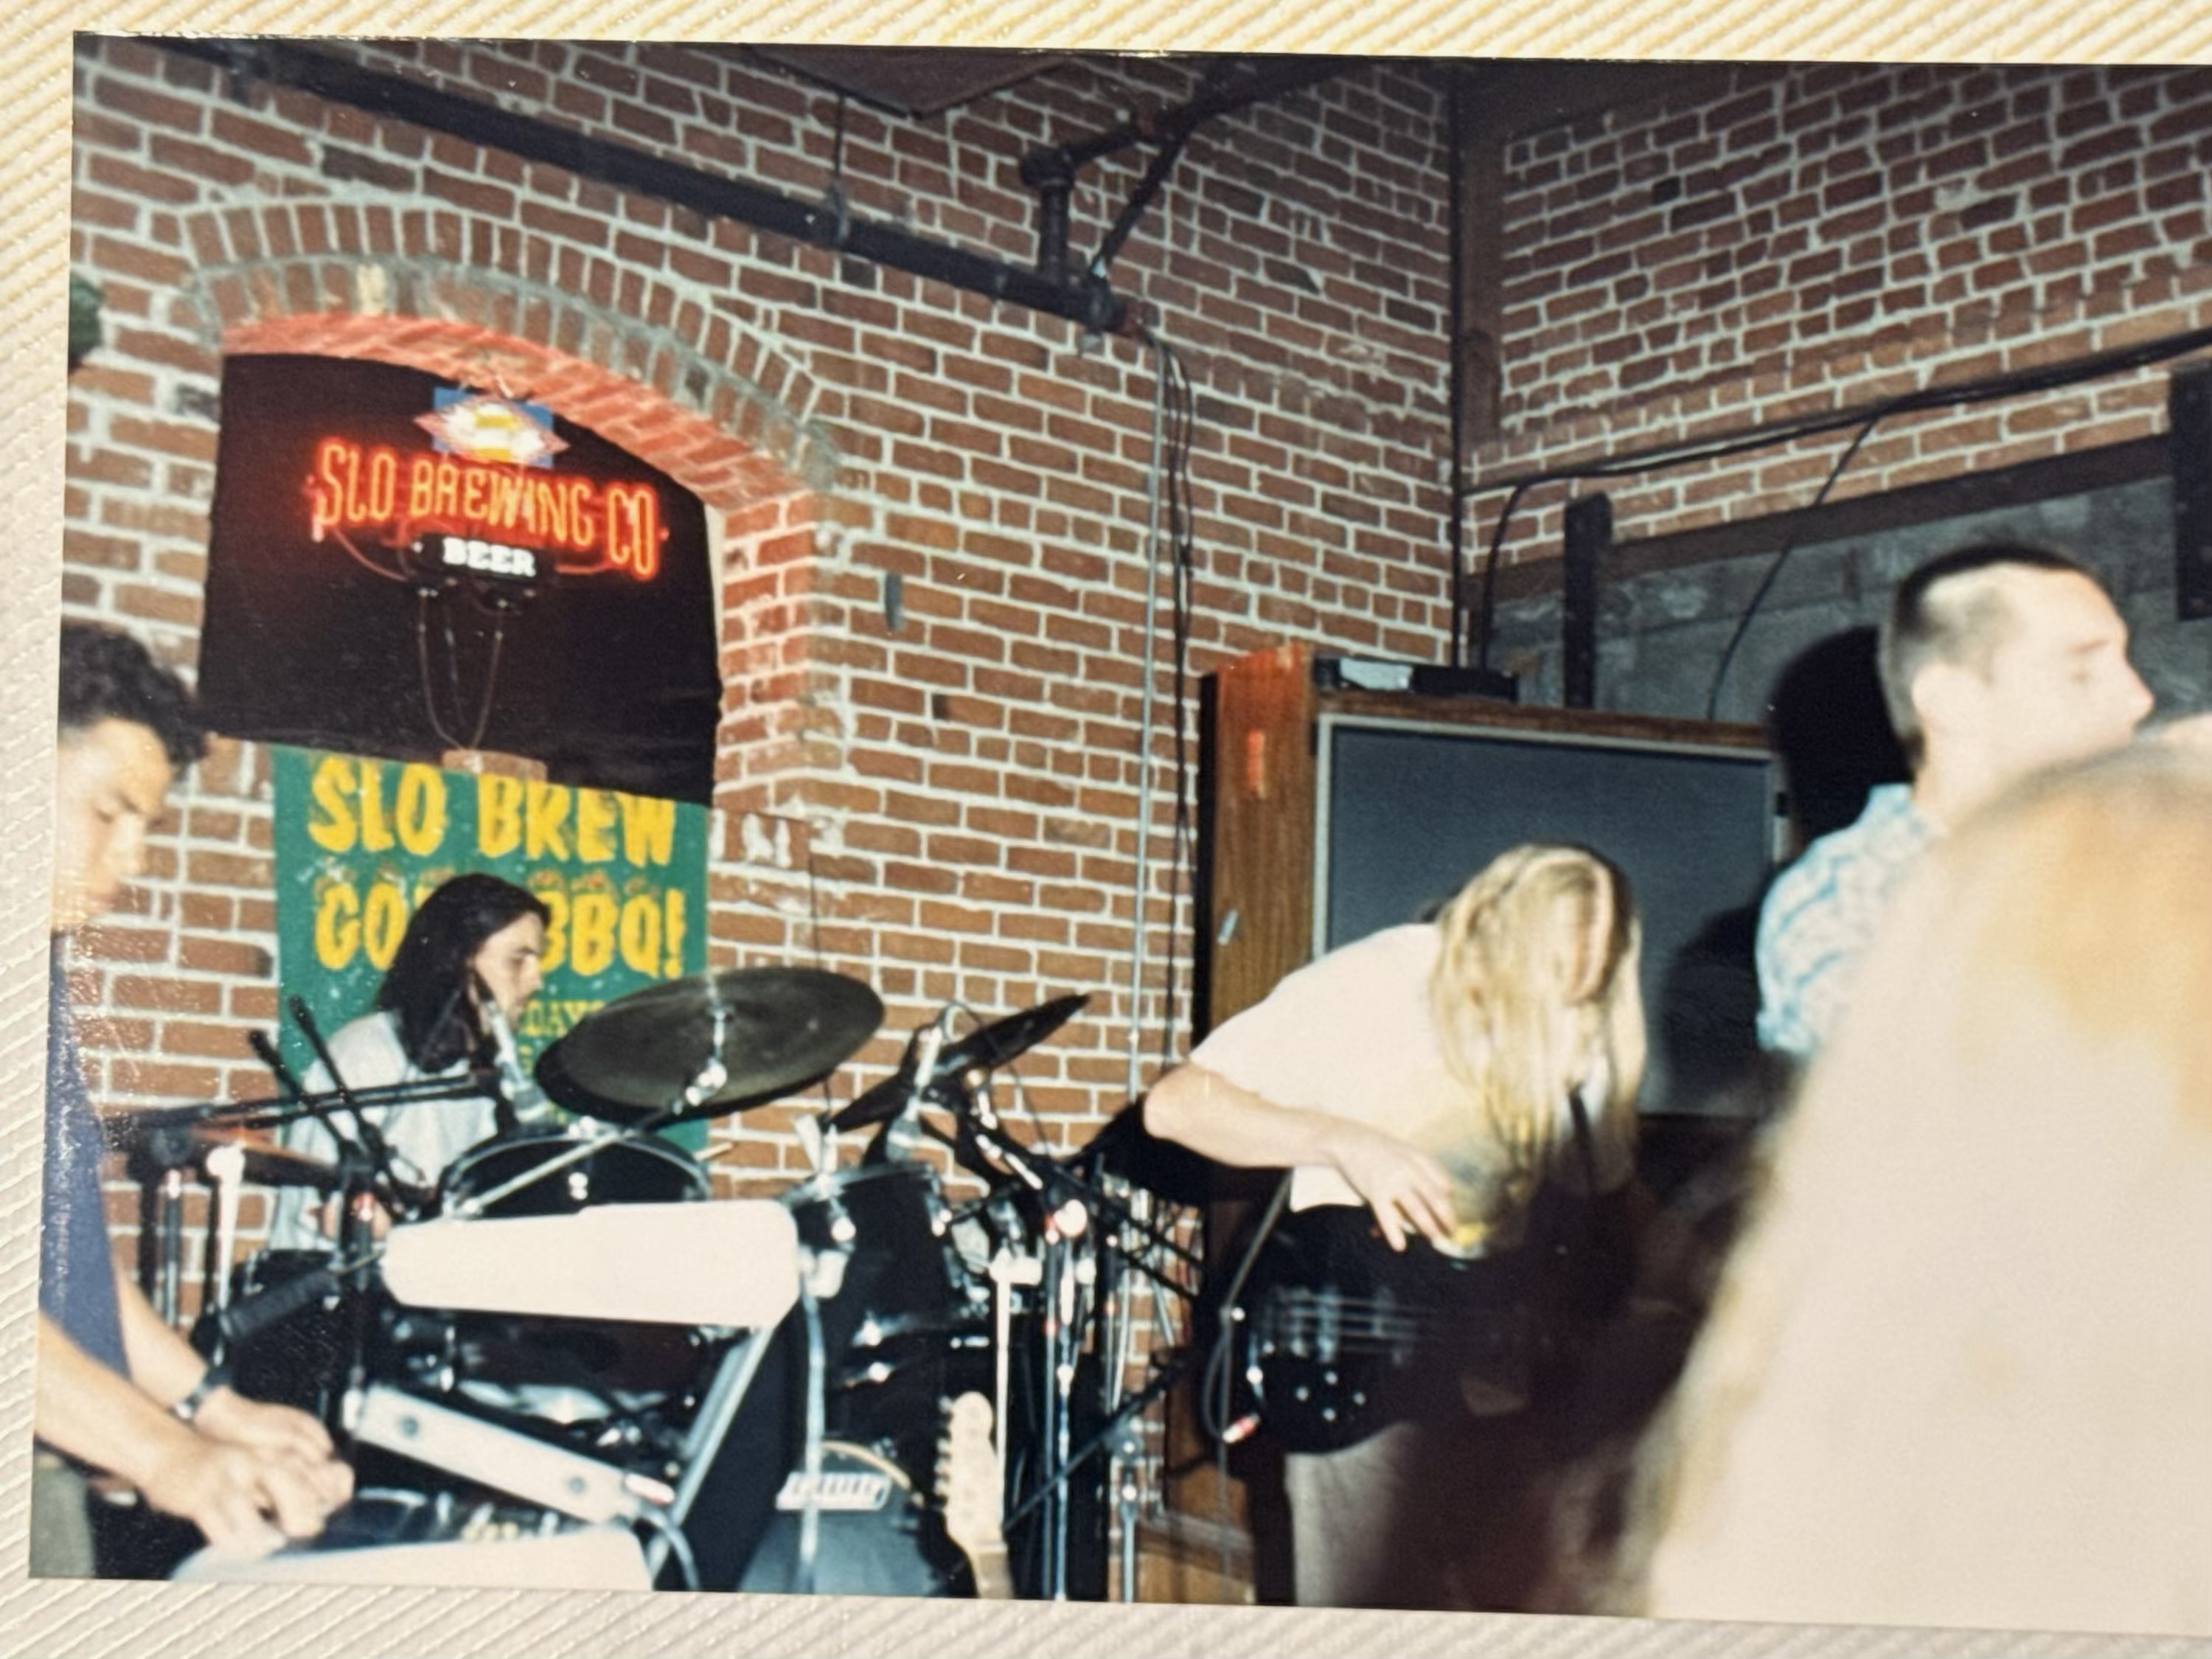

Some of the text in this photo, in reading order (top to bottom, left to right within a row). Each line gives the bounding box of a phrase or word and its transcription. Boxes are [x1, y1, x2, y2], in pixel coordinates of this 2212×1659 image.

[318, 441, 656, 577] SLO BREWING CO
[442, 536, 537, 578] BEER
[307, 755, 676, 868] SLO BREW
[538, 887, 686, 980] BBQ!
